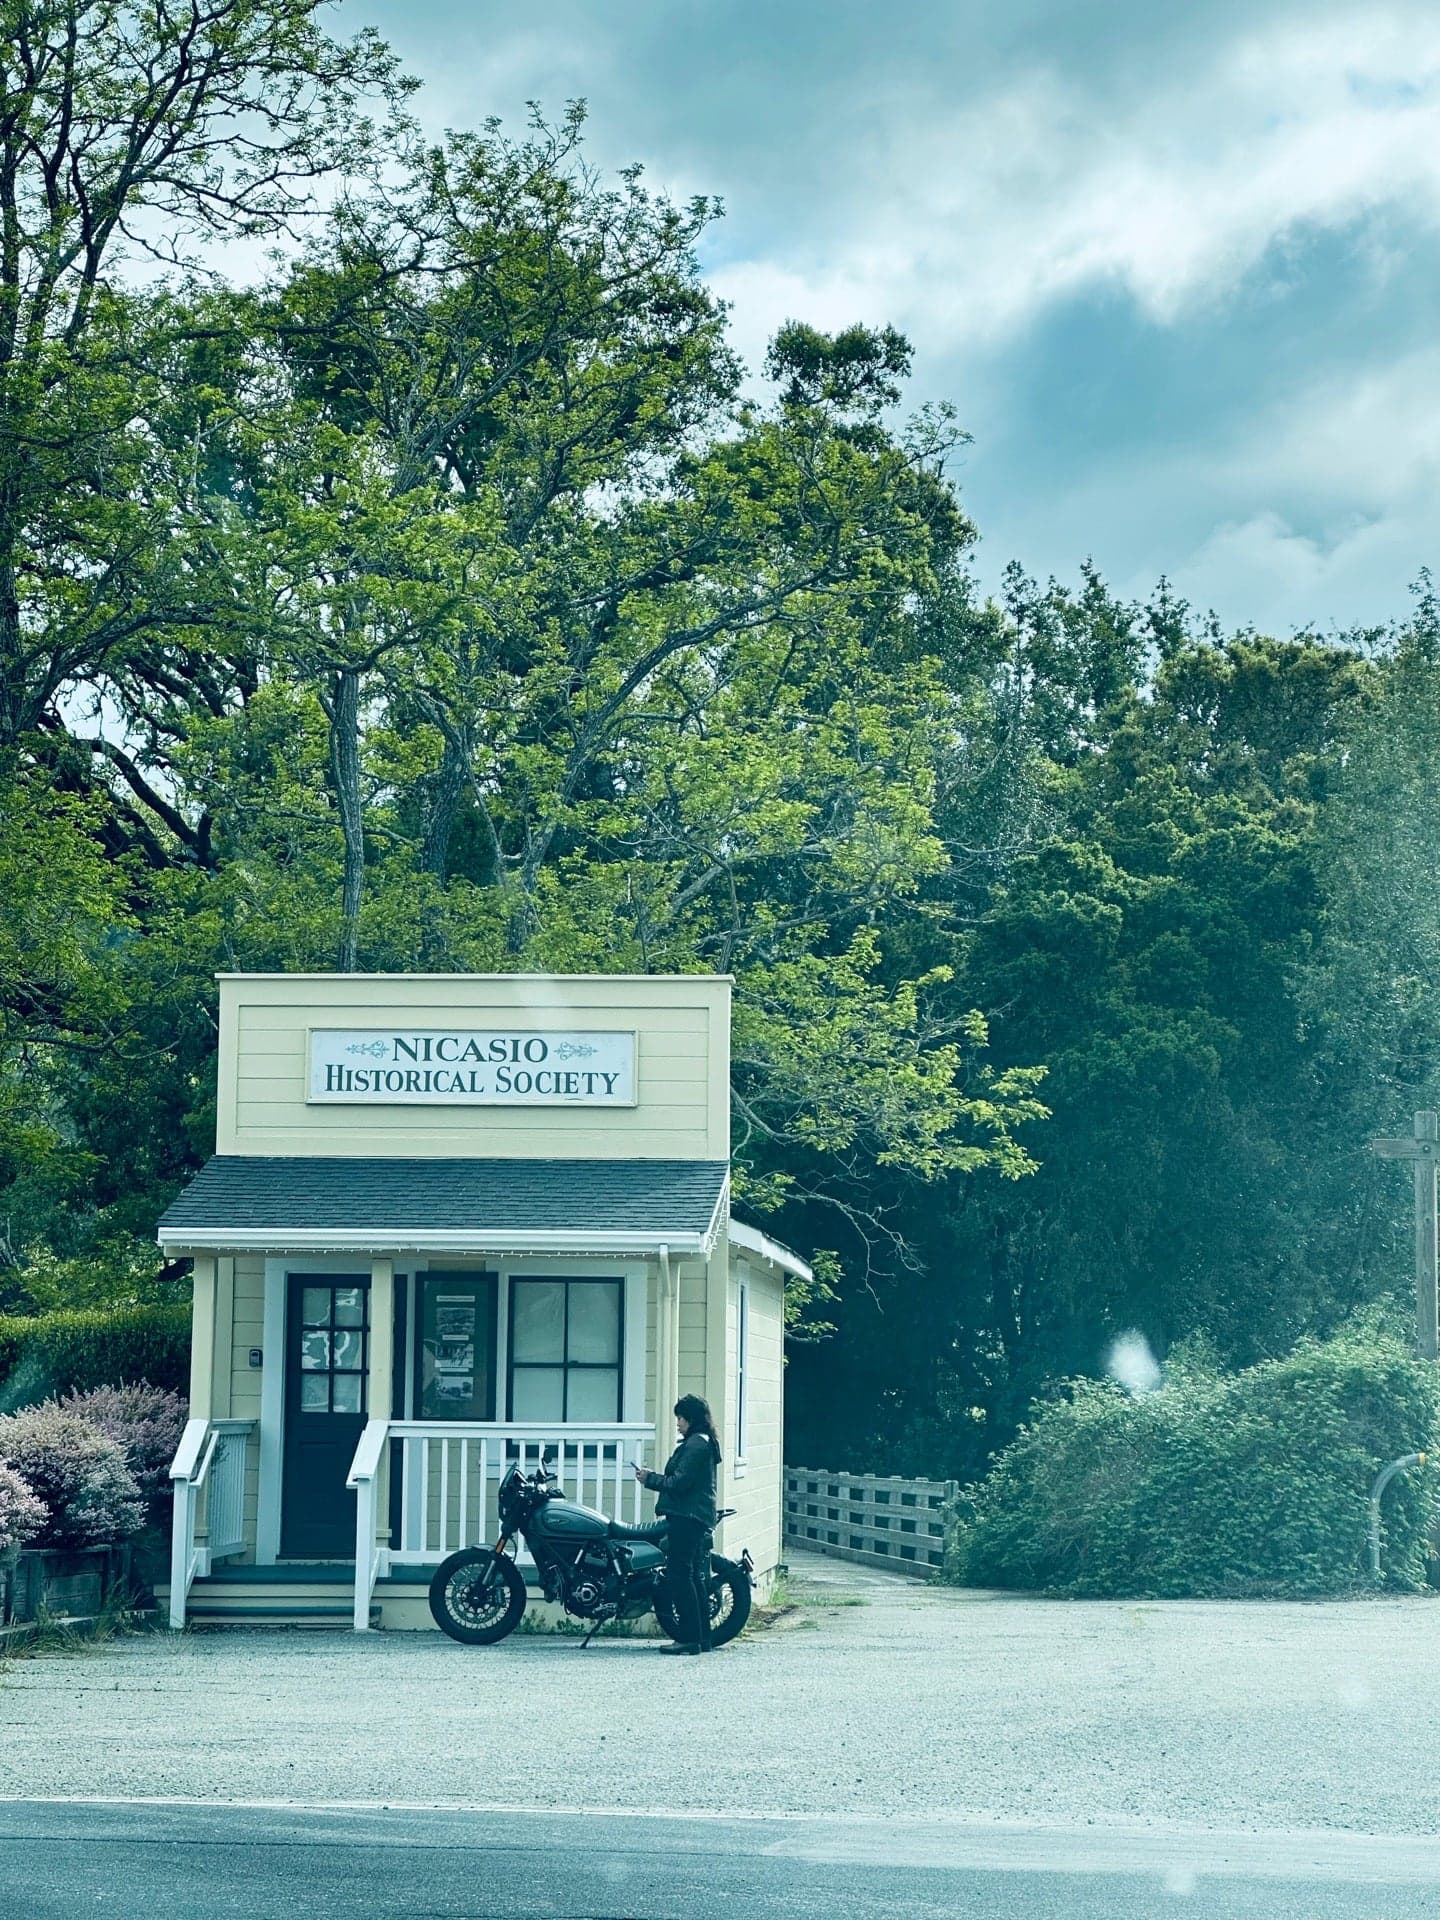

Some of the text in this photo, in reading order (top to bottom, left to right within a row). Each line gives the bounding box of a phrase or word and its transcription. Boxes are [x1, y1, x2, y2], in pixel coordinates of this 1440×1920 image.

[392, 1038, 548, 1063] NICASIO
[325, 1064, 621, 1095] HISTORICAL SOCIETY
